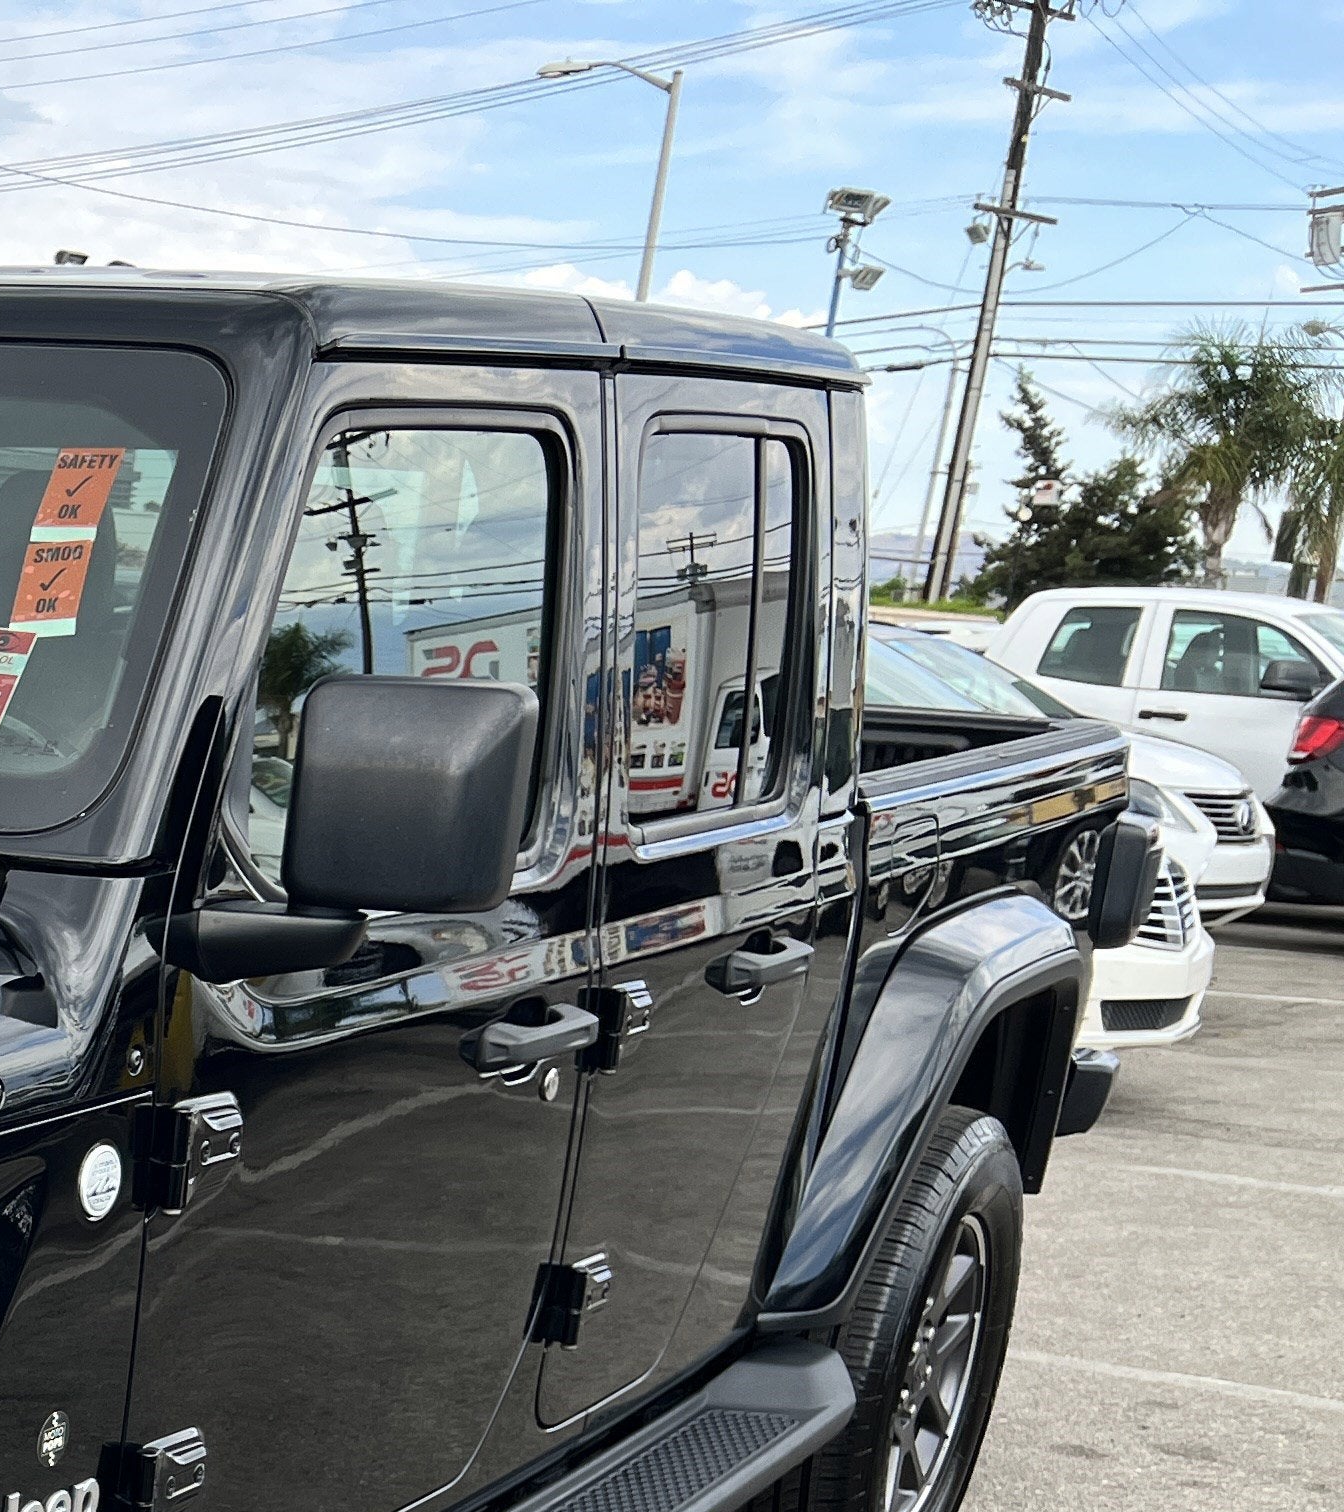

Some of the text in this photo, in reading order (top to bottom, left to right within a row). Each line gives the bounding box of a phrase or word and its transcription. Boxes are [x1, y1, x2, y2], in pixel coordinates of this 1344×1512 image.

[57, 453, 120, 470] SAFETY
[58, 504, 82, 519] OK
[33, 544, 84, 563] SMOG
[35, 597, 59, 613] OK
